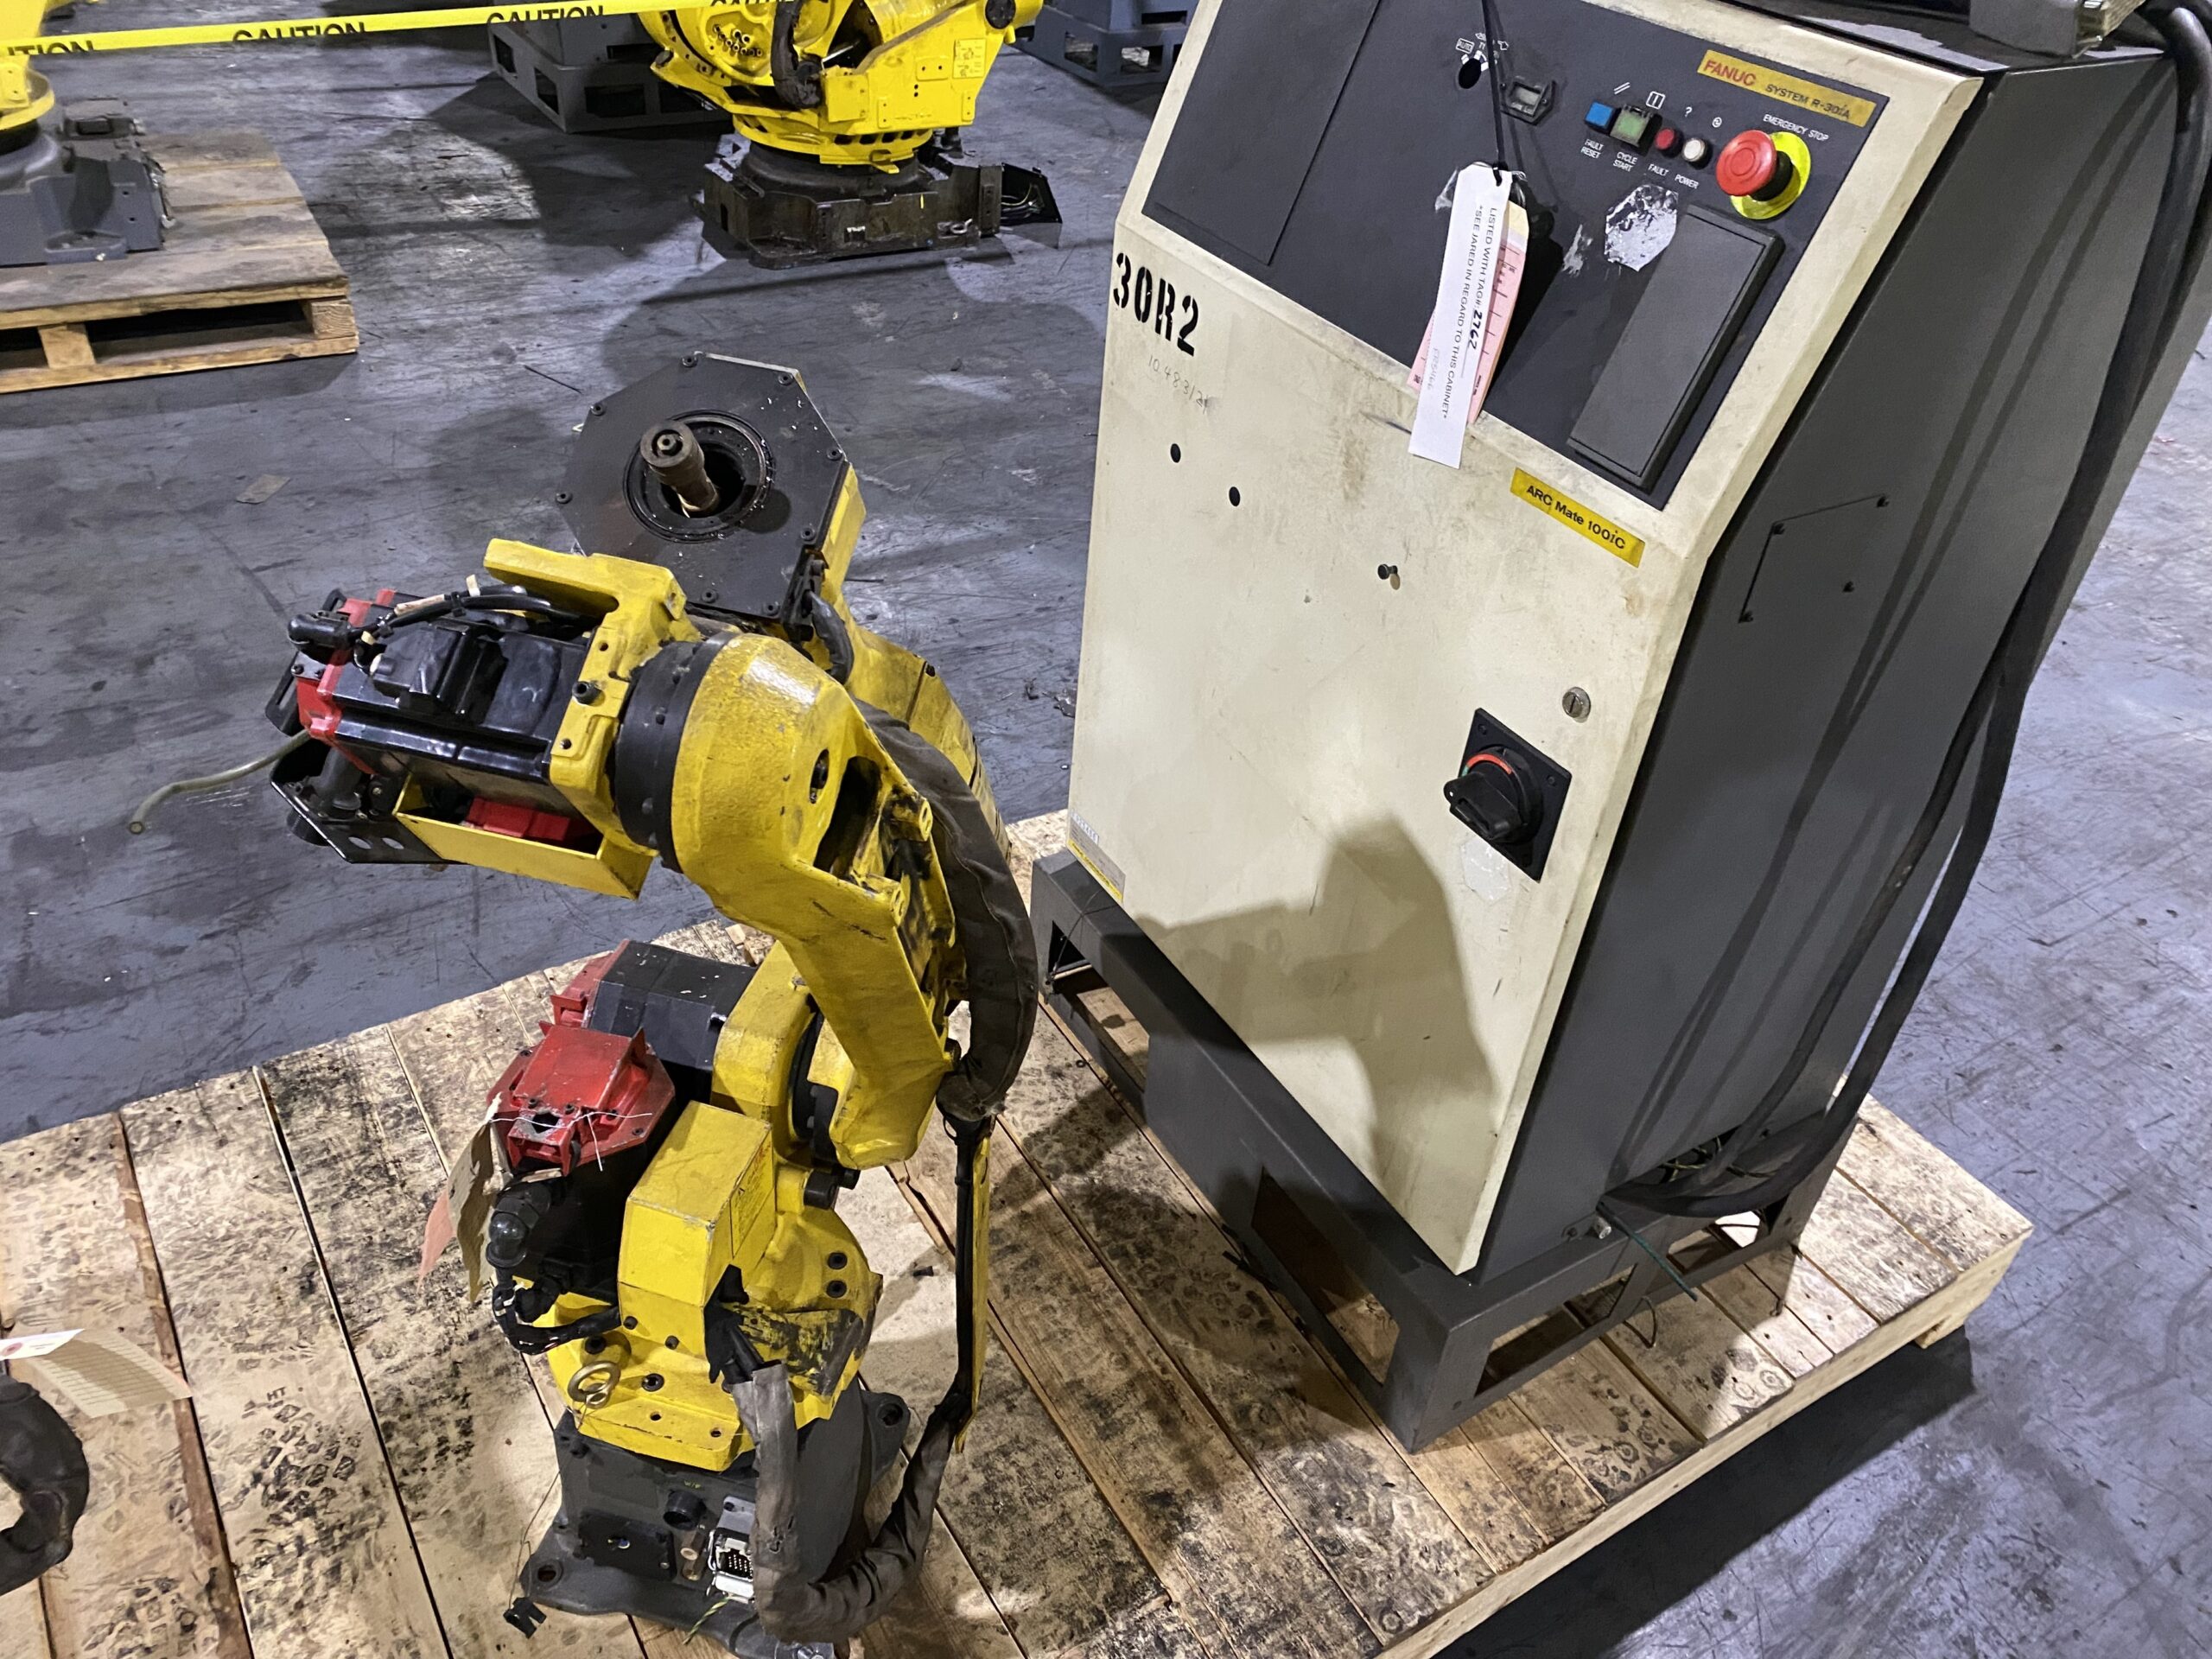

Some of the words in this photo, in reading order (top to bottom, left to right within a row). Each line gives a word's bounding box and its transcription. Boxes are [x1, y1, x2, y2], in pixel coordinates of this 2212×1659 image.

[1702, 60, 1757, 86] FANUC
[1765, 85, 1808, 105] SYSTEM
[1763, 114, 1808, 134] EMERGENCY
[1808, 130, 1830, 142] STOP
[1580, 146, 1601, 159] RESET
[1585, 139, 1605, 150] FAULT
[1613, 160, 1634, 172] START
[1617, 151, 1638, 164] CYCLE
[1648, 164, 1669, 176] FAULT
[1675, 174, 1700, 189] POWER
[1485, 207, 1497, 245] LISTED
[1467, 232, 1478, 267] JARED
[1479, 247, 1491, 276] WITH
[1465, 269, 1473, 281] IN
[1113, 252, 1199, 357] 30R2
[1457, 283, 1471, 325] REGARD
[1454, 329, 1463, 343] TO
[1469, 309, 1483, 350] 2762
[1449, 346, 1459, 369] THIS
[1526, 486, 1553, 506] ARC
[1554, 500, 1585, 525] Mate
